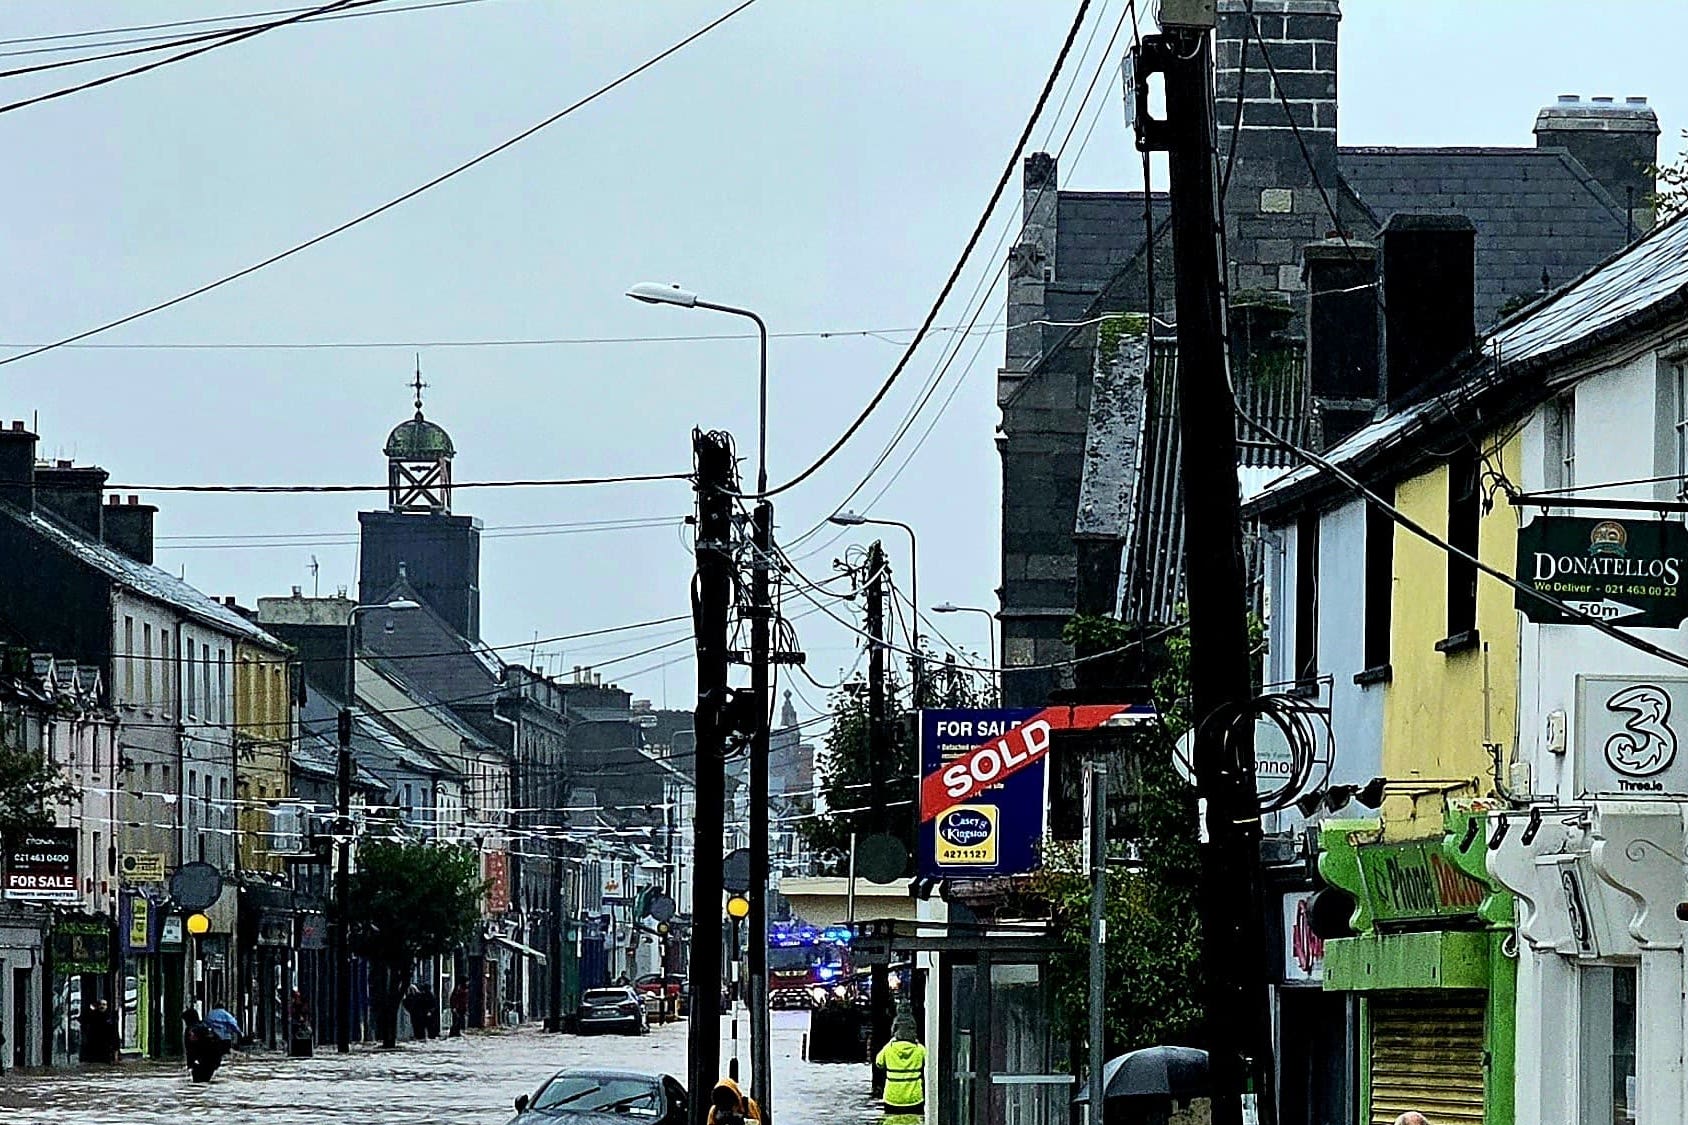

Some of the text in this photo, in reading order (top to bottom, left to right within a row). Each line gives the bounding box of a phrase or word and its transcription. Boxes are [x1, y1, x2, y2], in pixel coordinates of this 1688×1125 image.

[1533, 552, 1680, 586] DONATELLOS
[1533, 581, 1551, 592] We
[1553, 582, 1592, 593] Deliver
[1604, 584, 1623, 594] 021
[1626, 584, 1646, 595] 463
[1648, 585, 1662, 596] 00
[1663, 586, 1677, 597] 22
[1578, 603, 1619, 617] 50m
[937, 721, 1022, 737] FOR SAL
[1604, 684, 1678, 778] 3
[943, 719, 1050, 798] SOLD
[1617, 779, 1663, 792] Three.ie
[948, 812, 980, 827] Casey
[941, 828, 988, 844] Kingston
[943, 850, 987, 858] 4271127
[10, 875, 74, 888] FOR SALE
[1386, 855, 1435, 910] Phone
